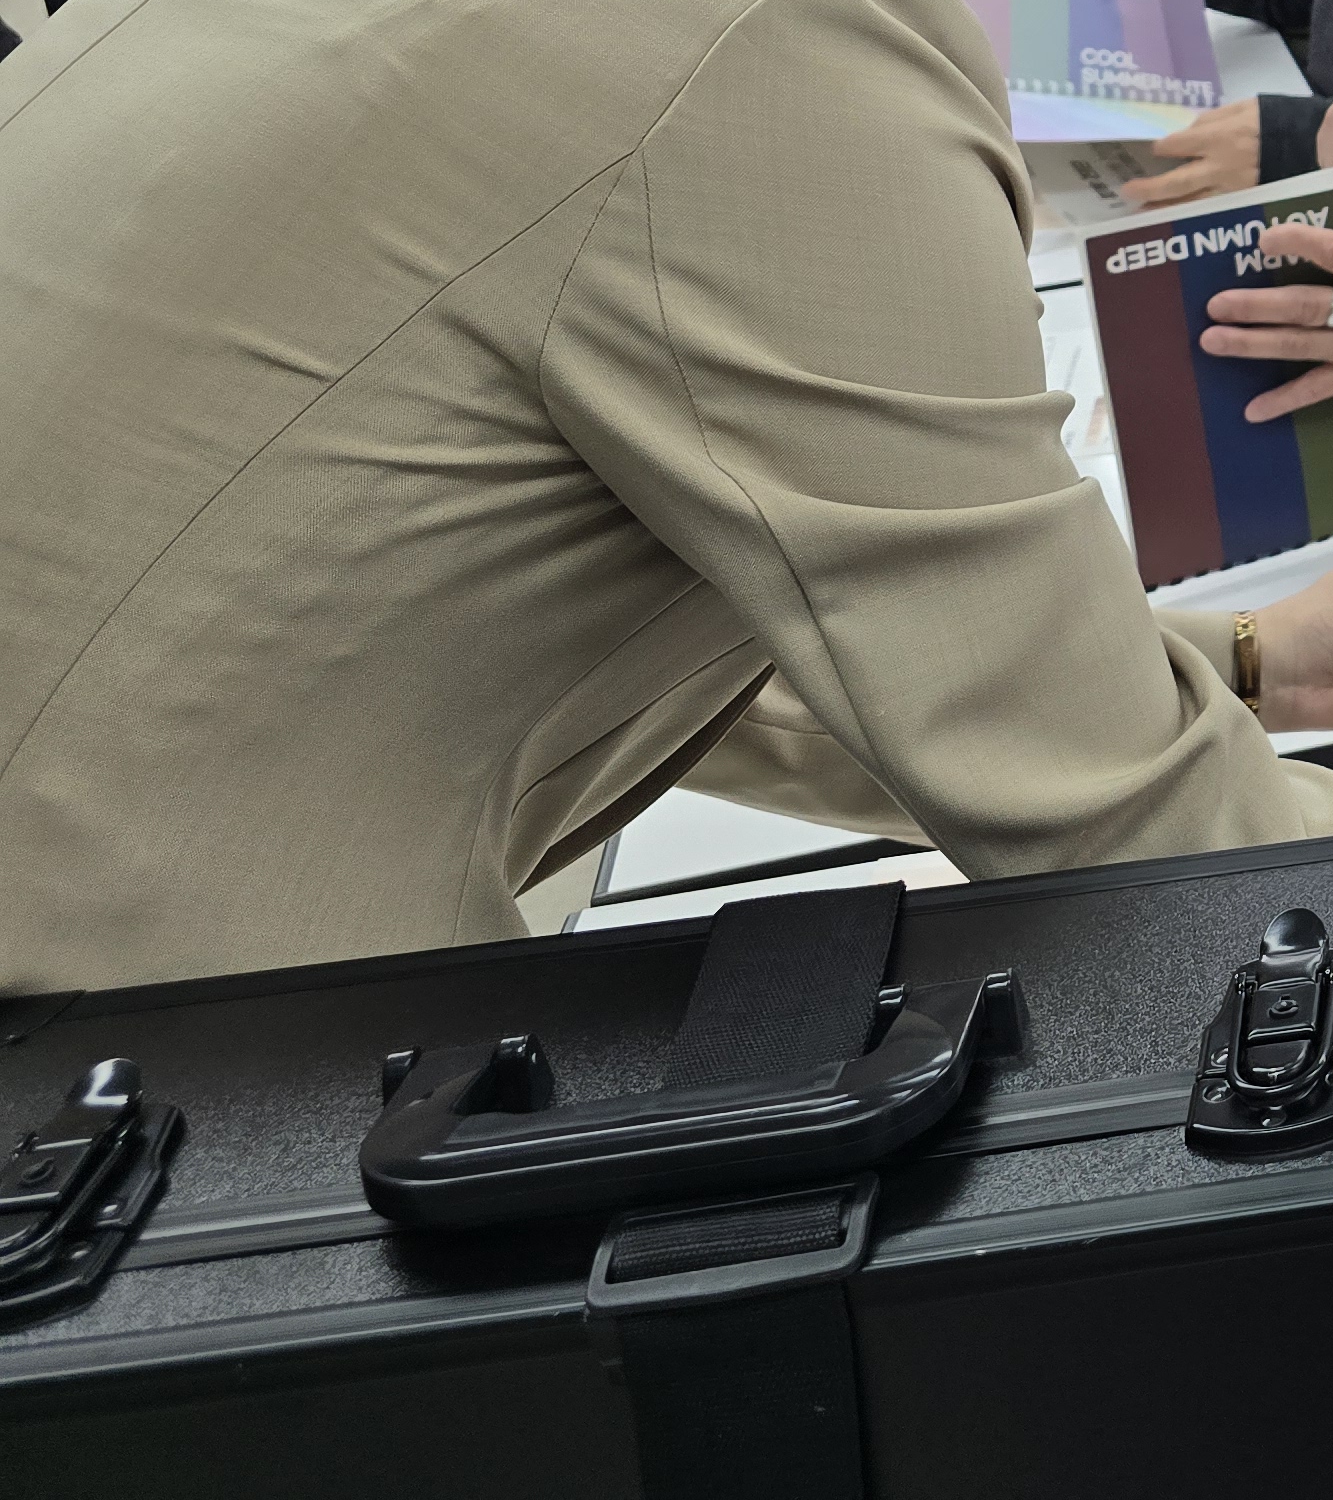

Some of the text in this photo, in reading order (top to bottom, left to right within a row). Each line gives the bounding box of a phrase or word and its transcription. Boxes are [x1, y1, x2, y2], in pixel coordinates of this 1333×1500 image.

[1079, 47, 1140, 70] COOL
[1106, 234, 1189, 274] DEEP
[1233, 247, 1308, 277] RM
